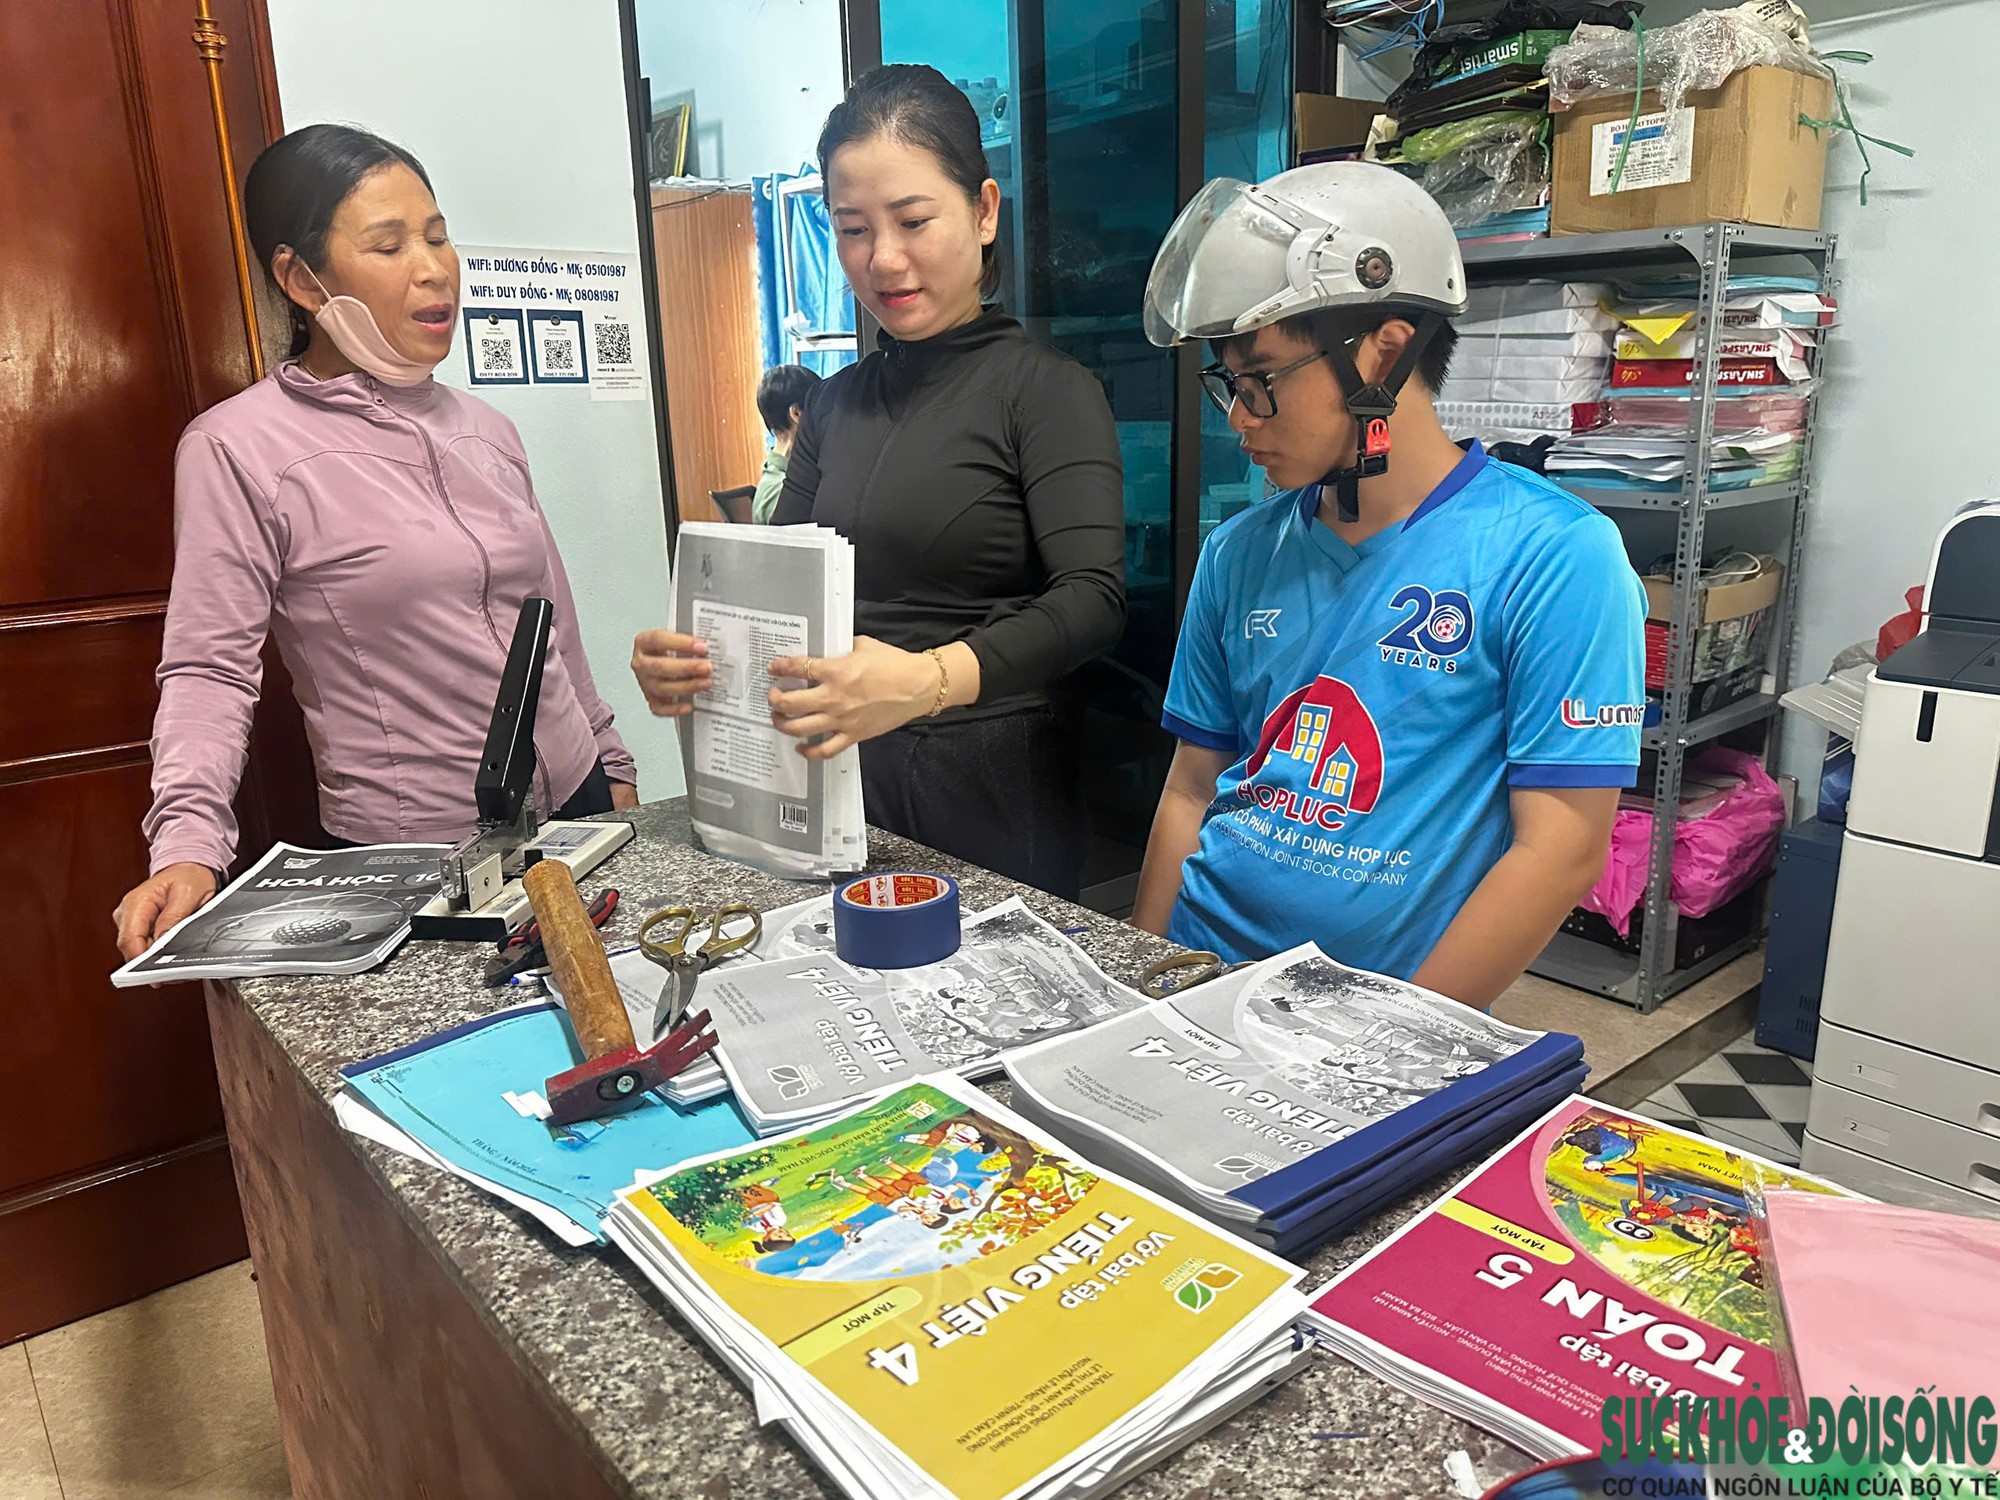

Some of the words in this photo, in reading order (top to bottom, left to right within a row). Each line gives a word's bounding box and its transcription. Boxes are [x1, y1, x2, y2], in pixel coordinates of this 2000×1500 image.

[1460, 41, 1519, 74] smartist
[467, 258, 492, 272] WIFI:
[585, 264, 626, 277] 05101987
[470, 285, 494, 298] WIFI:
[496, 286, 517, 299] DUY
[574, 289, 619, 302] 08081987
[1376, 584, 1475, 657] 20
[1380, 648, 1457, 674] YEARS
[1235, 807, 1253, 826] CỔ
[1249, 813, 1272, 837] PHẦN
[1273, 825, 1300, 847] XÂY
[1302, 837, 1345, 858] DỰNG
[1347, 845, 1381, 869] HỢP
[1383, 848, 1412, 869] LỰC
[1219, 823, 1271, 857] CONSTRUCTION
[1270, 848, 1301, 869] JOINT
[1302, 858, 1341, 879] STOCK
[1342, 867, 1409, 886] COMPANY
[254, 874, 328, 887] HOÁ
[326, 873, 398, 886] HỌC
[414, 872, 441, 884] 10
[784, 959, 830, 988] 4
[808, 973, 859, 1015] VIỆT
[812, 1016, 841, 1044] tập
[842, 1007, 904, 1073] TIẾNG
[1184, 1029, 1201, 1040] MỘT
[1200, 1037, 1220, 1050] TẬP
[826, 1039, 852, 1066] bài
[1129, 1034, 1177, 1065] 4
[841, 1062, 865, 1085] Vở
[1169, 1049, 1248, 1096] VIỆT
[1856, 1065, 1863, 1074] 1
[1222, 1103, 1259, 1128] tập
[1246, 1089, 1354, 1143] TIẾNG
[1850, 1121, 1858, 1132] 2
[1260, 1122, 1293, 1147] bài
[1698, 1162, 1721, 1172] NAM
[1137, 1232, 1172, 1255] Vở
[1491, 1225, 1520, 1239] MỘT
[1522, 1239, 1545, 1250] TẬP
[1016, 1214, 1127, 1288] TIẾNG
[1100, 1253, 1144, 1284] bài
[1477, 1255, 1531, 1288] 5
[1061, 1280, 1105, 1308] tập
[843, 1314, 870, 1332] MỘT
[873, 1302, 895, 1316] TẬP
[926, 1288, 1022, 1346] VIỆT
[1546, 1281, 1741, 1381] TOÁN
[871, 1347, 918, 1384] 4
[1561, 1336, 1610, 1367] tập
[1614, 1363, 1669, 1397] bài
